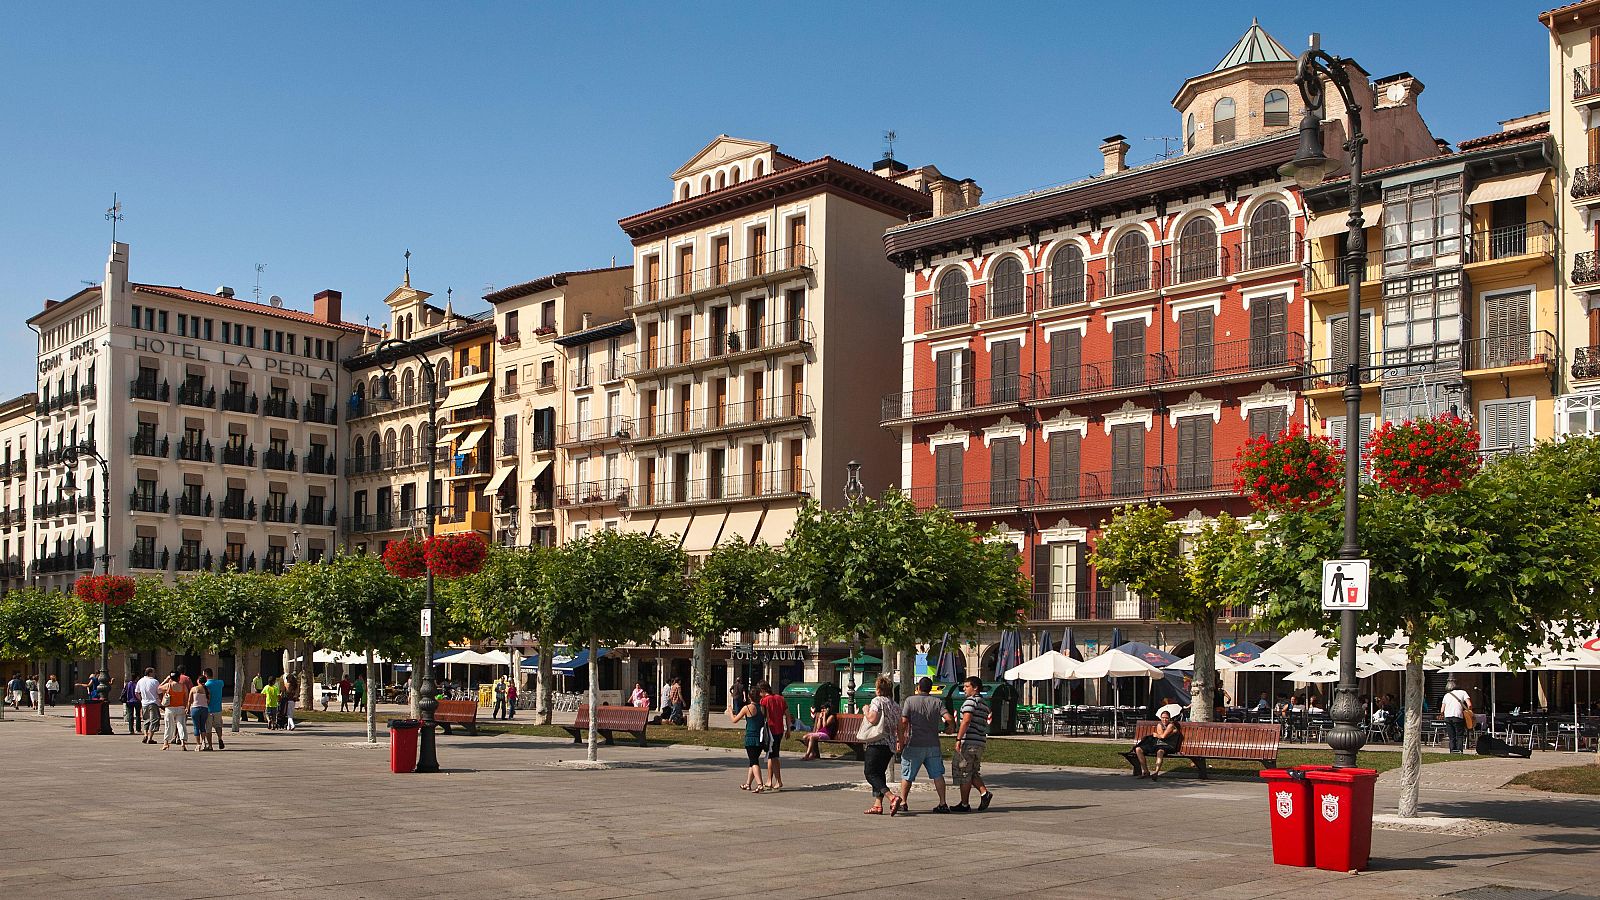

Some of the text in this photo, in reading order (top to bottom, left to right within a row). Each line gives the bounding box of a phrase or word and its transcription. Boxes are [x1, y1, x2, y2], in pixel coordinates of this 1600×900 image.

[70, 338, 97, 361] HOTEL
[134, 336, 333, 381] HOTEL LA PERLA
[772, 650, 804, 660] AUMA
